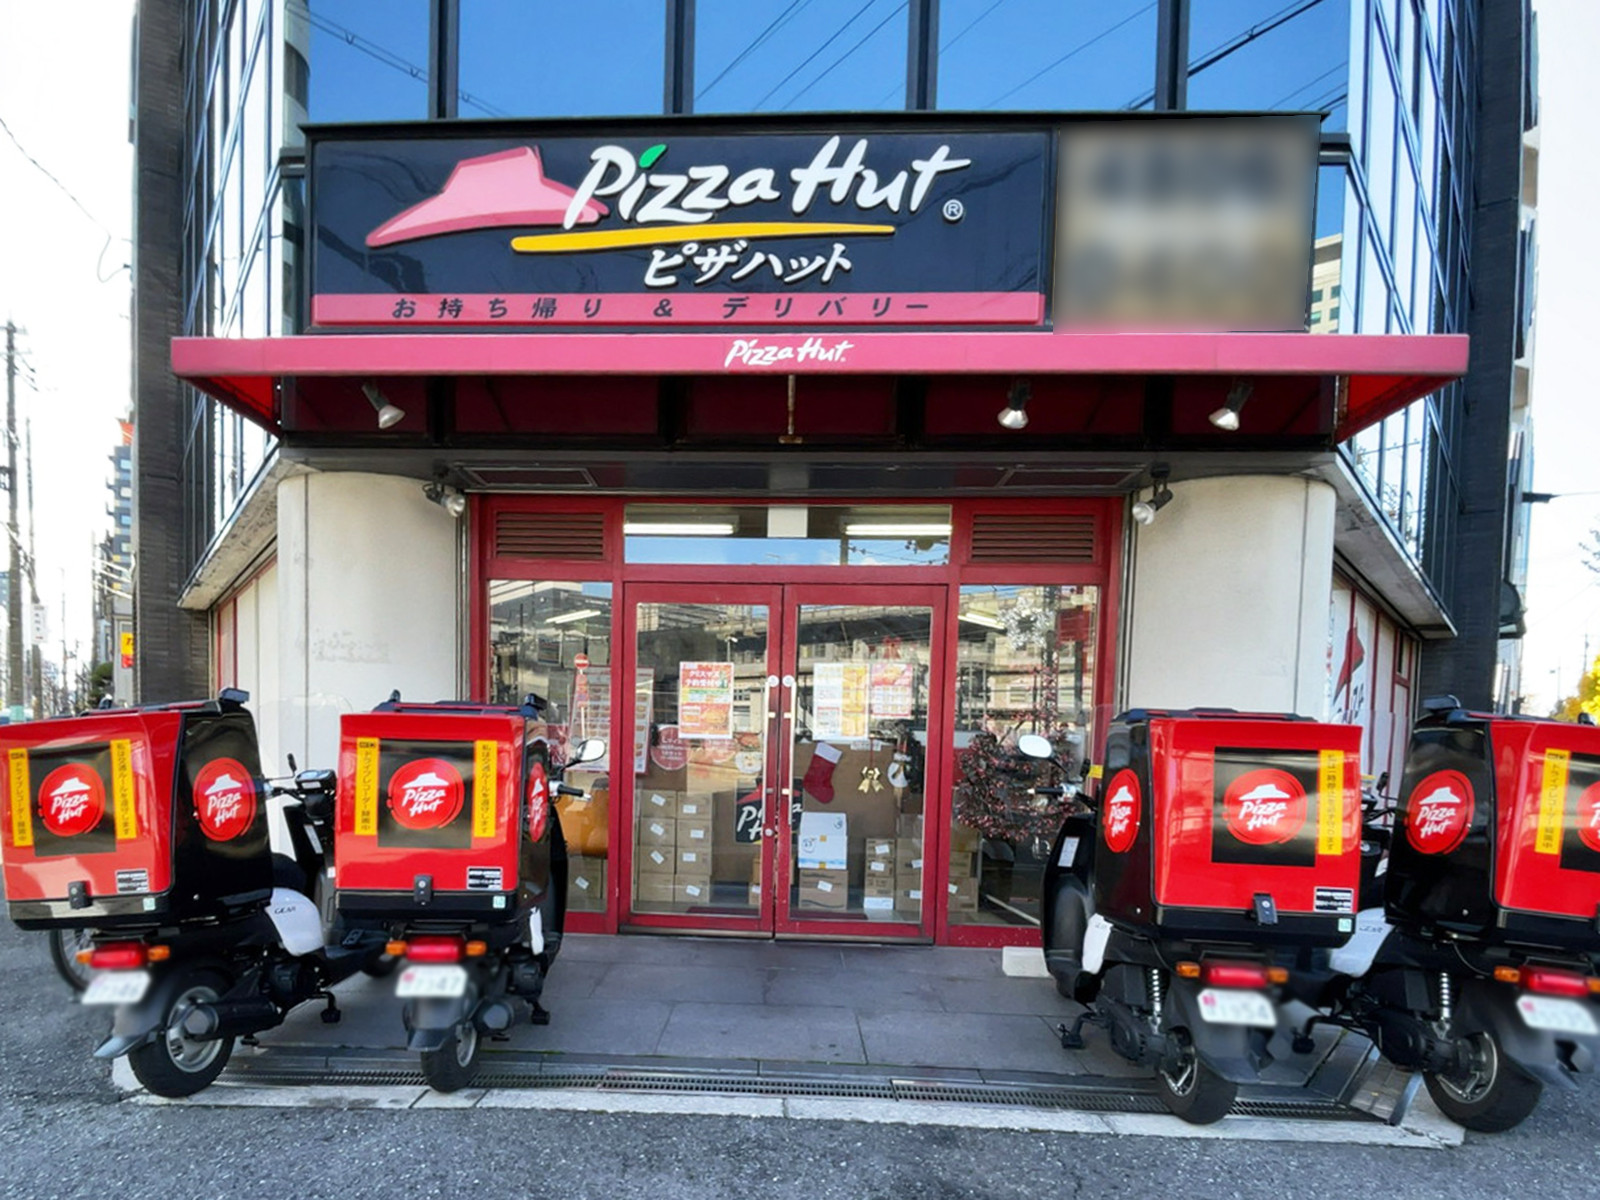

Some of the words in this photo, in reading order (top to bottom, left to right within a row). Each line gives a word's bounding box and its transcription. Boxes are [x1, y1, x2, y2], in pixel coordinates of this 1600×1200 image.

[563, 144, 780, 230] Pizza
[791, 135, 971, 213] Hut
[643, 240, 852, 287] ピザハット
[392, 297, 602, 318] お持ち帰り
[653, 298, 674, 317] &
[723, 296, 928, 319] デリバリー
[724, 338, 794, 367] Pizza
[797, 337, 854, 362] Hut
[51, 793, 88, 815] Pizza
[207, 791, 242, 817] Pizza
[402, 787, 446, 807] Pizza
[409, 799, 444, 817] Hut
[58, 803, 88, 824] Hut
[214, 803, 241, 828] Hut
[1108, 803, 1132, 825] Pizza
[1239, 799, 1287, 820] Pizza
[1415, 803, 1456, 826] Pizza
[1111, 817, 1130, 838] Hut
[1246, 813, 1285, 831] Hut
[1420, 819, 1453, 838] Hut
